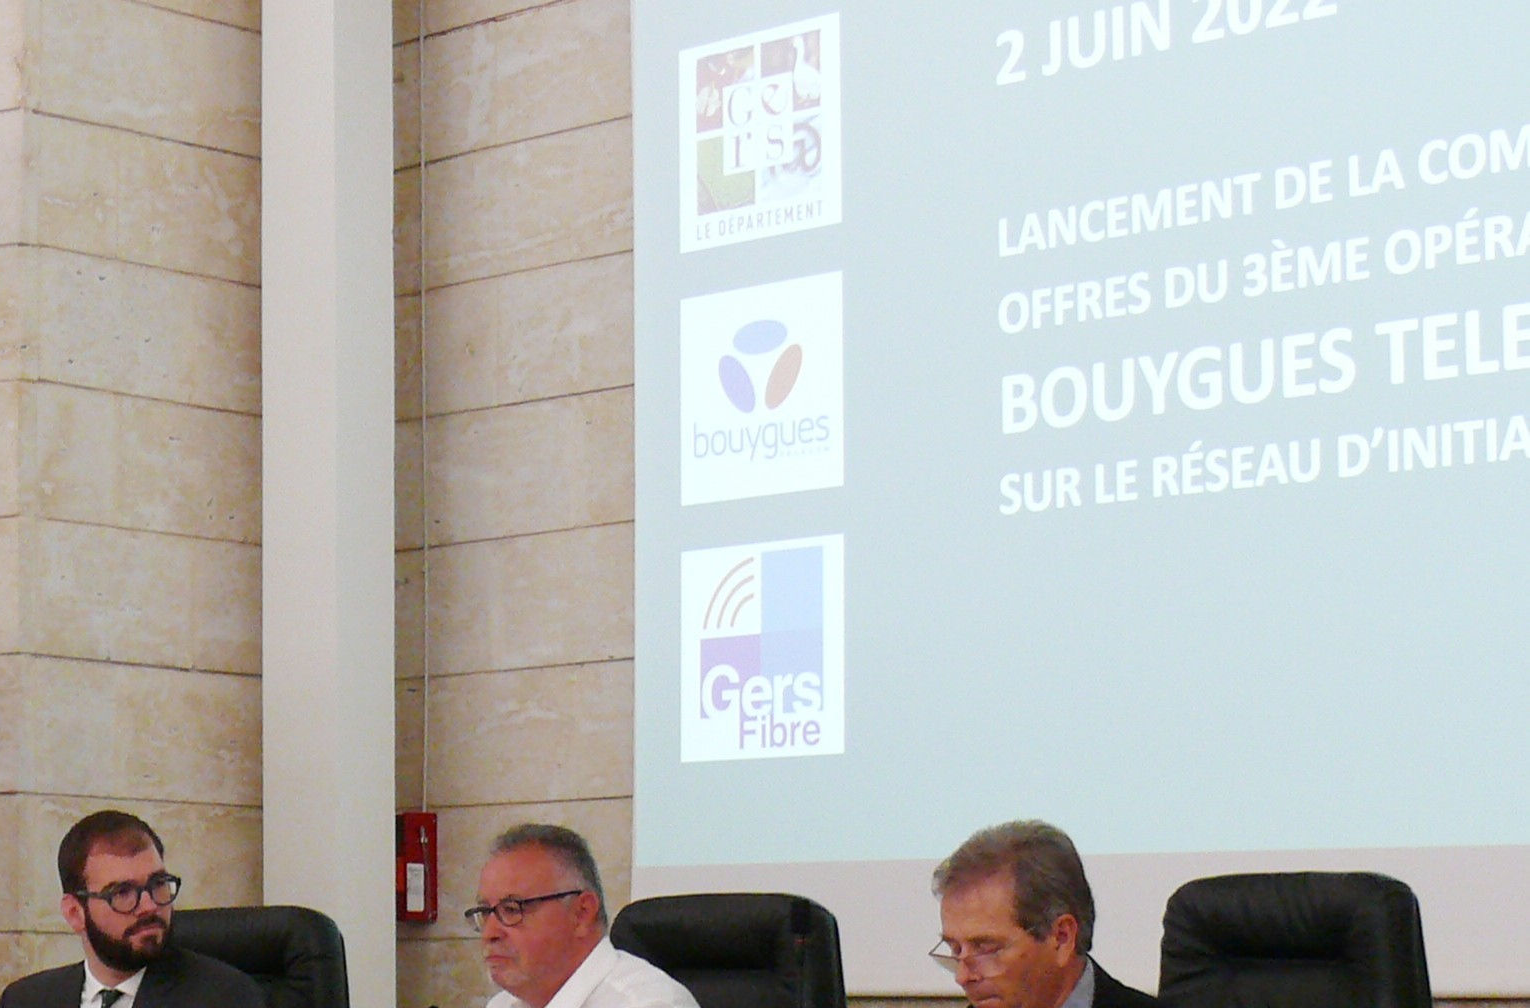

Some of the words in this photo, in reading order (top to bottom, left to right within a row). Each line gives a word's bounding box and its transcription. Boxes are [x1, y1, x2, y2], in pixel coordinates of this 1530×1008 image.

[995, 28, 1027, 86] 2
[1041, 0, 1171, 77] JUIN
[696, 221, 711, 242] LE
[718, 199, 823, 238] DÉPARTEMENT
[998, 171, 1262, 258] LANCEMENT
[1274, 158, 1334, 210] DE
[1348, 148, 1406, 197] LA
[997, 271, 1152, 334] OFFRES
[1164, 258, 1228, 309] DU
[1242, 235, 1371, 298] 3ÈME
[1001, 327, 1357, 435] BOUYGUES
[1374, 301, 1530, 386] TELE
[693, 415, 831, 462] bouygues
[998, 466, 1083, 516] SUR
[1094, 458, 1139, 504] LE
[1151, 437, 1321, 498] RÉSEAU
[701, 663, 822, 720] Gers
[739, 713, 822, 750] Fibre
